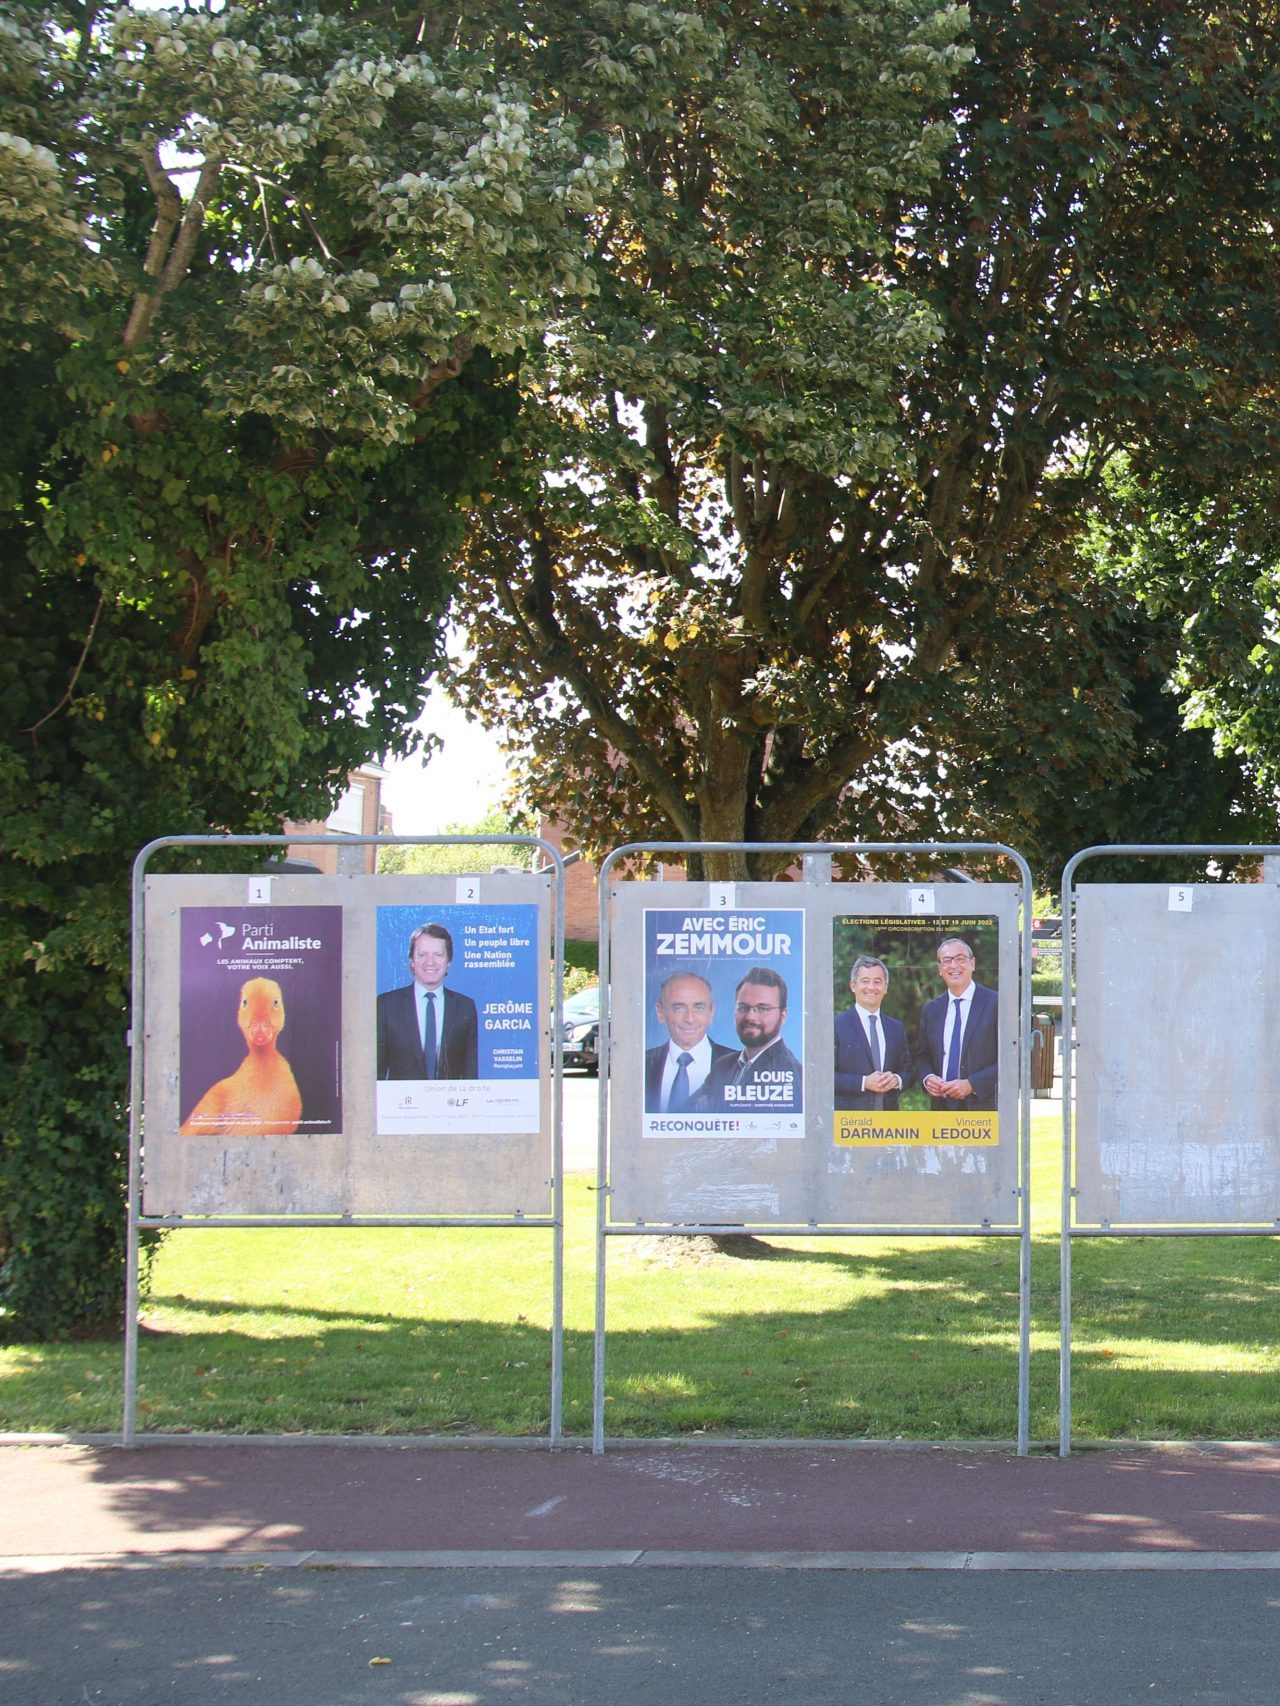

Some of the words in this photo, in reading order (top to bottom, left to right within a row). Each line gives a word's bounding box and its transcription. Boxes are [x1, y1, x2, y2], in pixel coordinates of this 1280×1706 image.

[256, 889, 262, 898] 1
[467, 889, 474, 898] 2
[1178, 892, 1184, 901] 5
[720, 896, 726, 905] 3
[918, 894, 925, 903] 4
[682, 917, 725, 931] AVEC
[729, 916, 766, 931] ÉRIC
[242, 923, 274, 936] Parti
[464, 926, 476, 934] Un
[479, 926, 496, 934] Etat
[242, 937, 321, 950] Animaliste
[479, 939, 507, 948] peuple
[656, 933, 791, 955] ZEMMOUR
[464, 959, 515, 968] rassemblée
[482, 1000, 533, 1014] JERÔME
[485, 1019, 531, 1030] GARCIA
[754, 1071, 794, 1082] LOUIS
[425, 1085, 446, 1093] Union
[724, 1083, 794, 1101] BLEUZÉ
[841, 1117, 872, 1126] Gérald
[956, 1118, 992, 1126] Vincent
[841, 1128, 919, 1139] DARMANIN
[932, 1128, 992, 1139] LEDOUX
